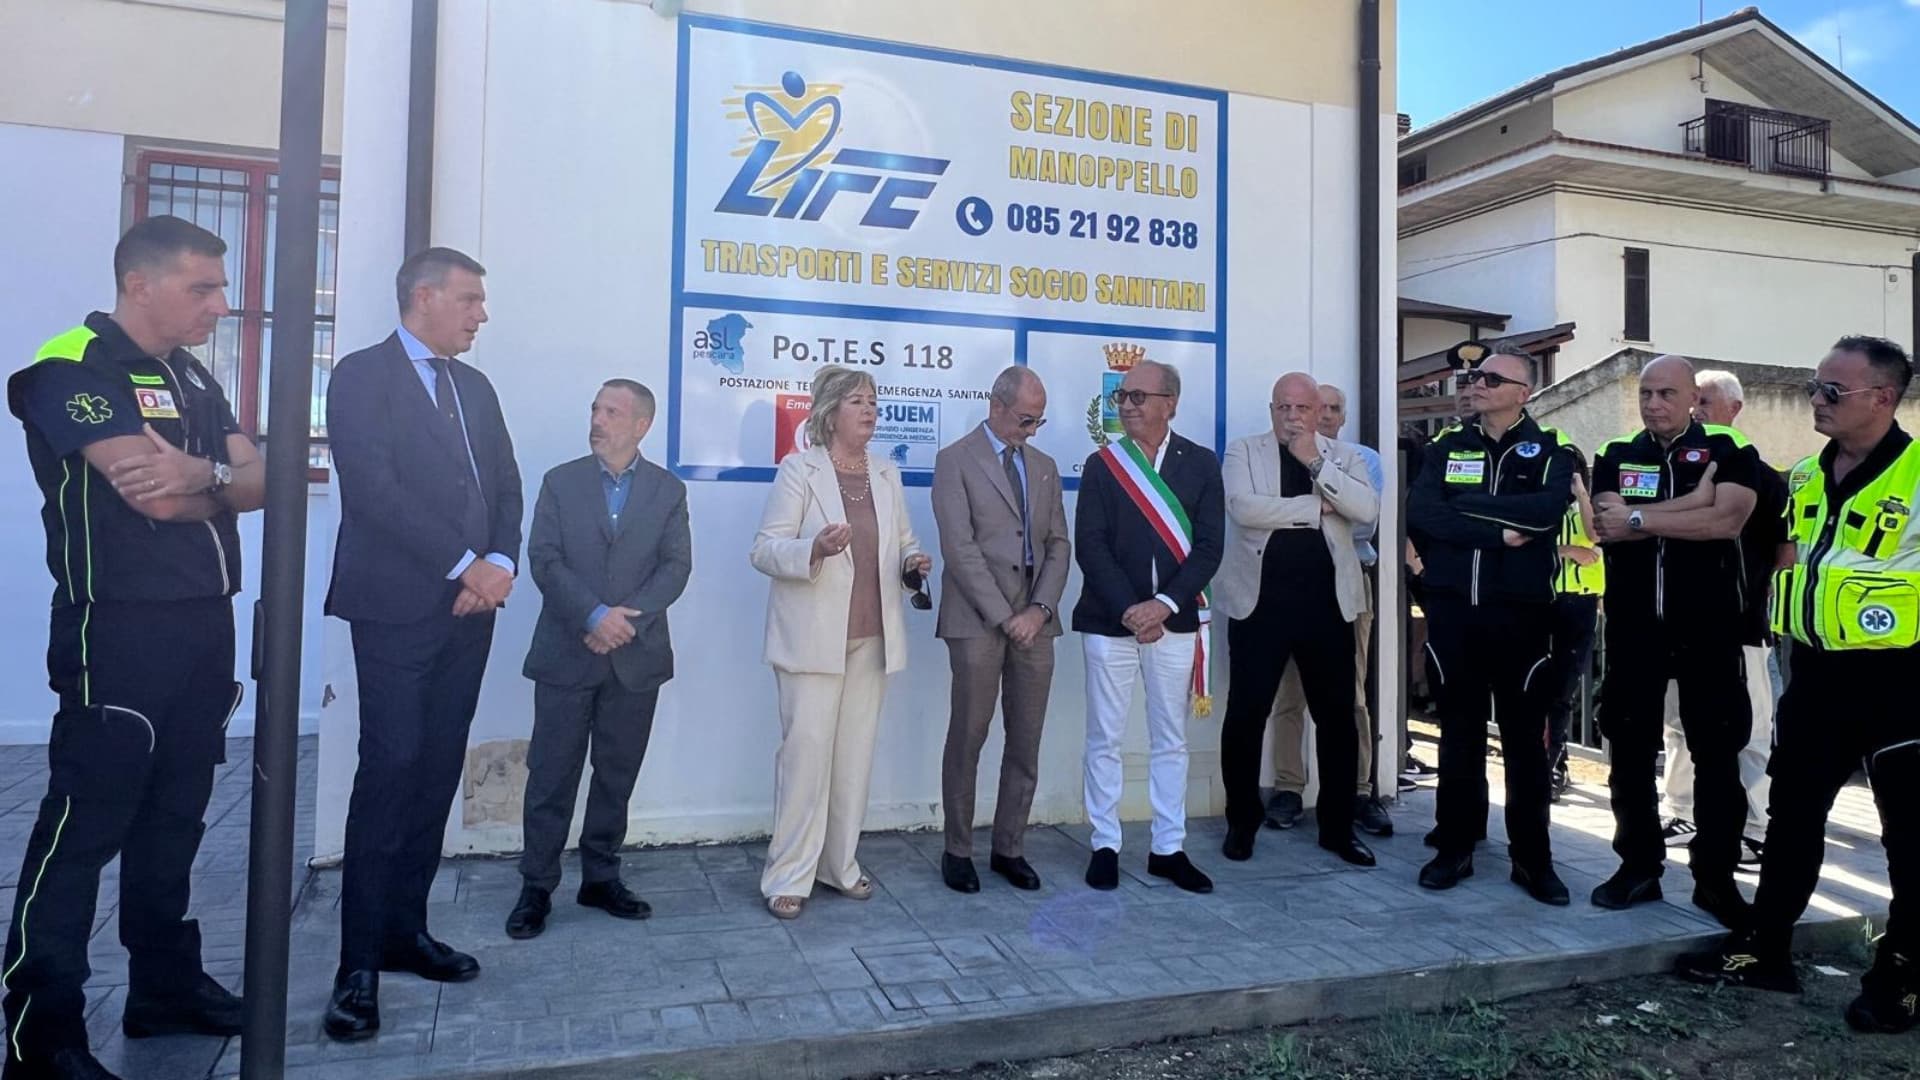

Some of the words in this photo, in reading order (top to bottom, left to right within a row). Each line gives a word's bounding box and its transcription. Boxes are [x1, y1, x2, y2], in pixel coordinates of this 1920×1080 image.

[1010, 90, 1152, 147] SEZIONE
[1165, 112, 1199, 153] DI
[1009, 145, 1199, 199] MANOPPELLO
[1006, 203, 1060, 236] 085
[1069, 209, 1098, 240] 21
[1106, 213, 1140, 244] 92
[1148, 217, 1199, 249] 838
[700, 239, 862, 284] TRASPORTI
[872, 253, 888, 286] E
[896, 256, 1002, 294] SERVIZI
[1009, 266, 1088, 302] SOCIO
[1095, 273, 1206, 312] SANITARI
[693, 327, 734, 350] asl
[773, 335, 885, 366] Po.T.E.S
[903, 343, 953, 370] 118
[719, 377, 790, 391] POSTAZIONE
[877, 385, 942, 398] EMERGENZA
[947, 389, 991, 400] SANITAR
[885, 404, 934, 424] SUEM
